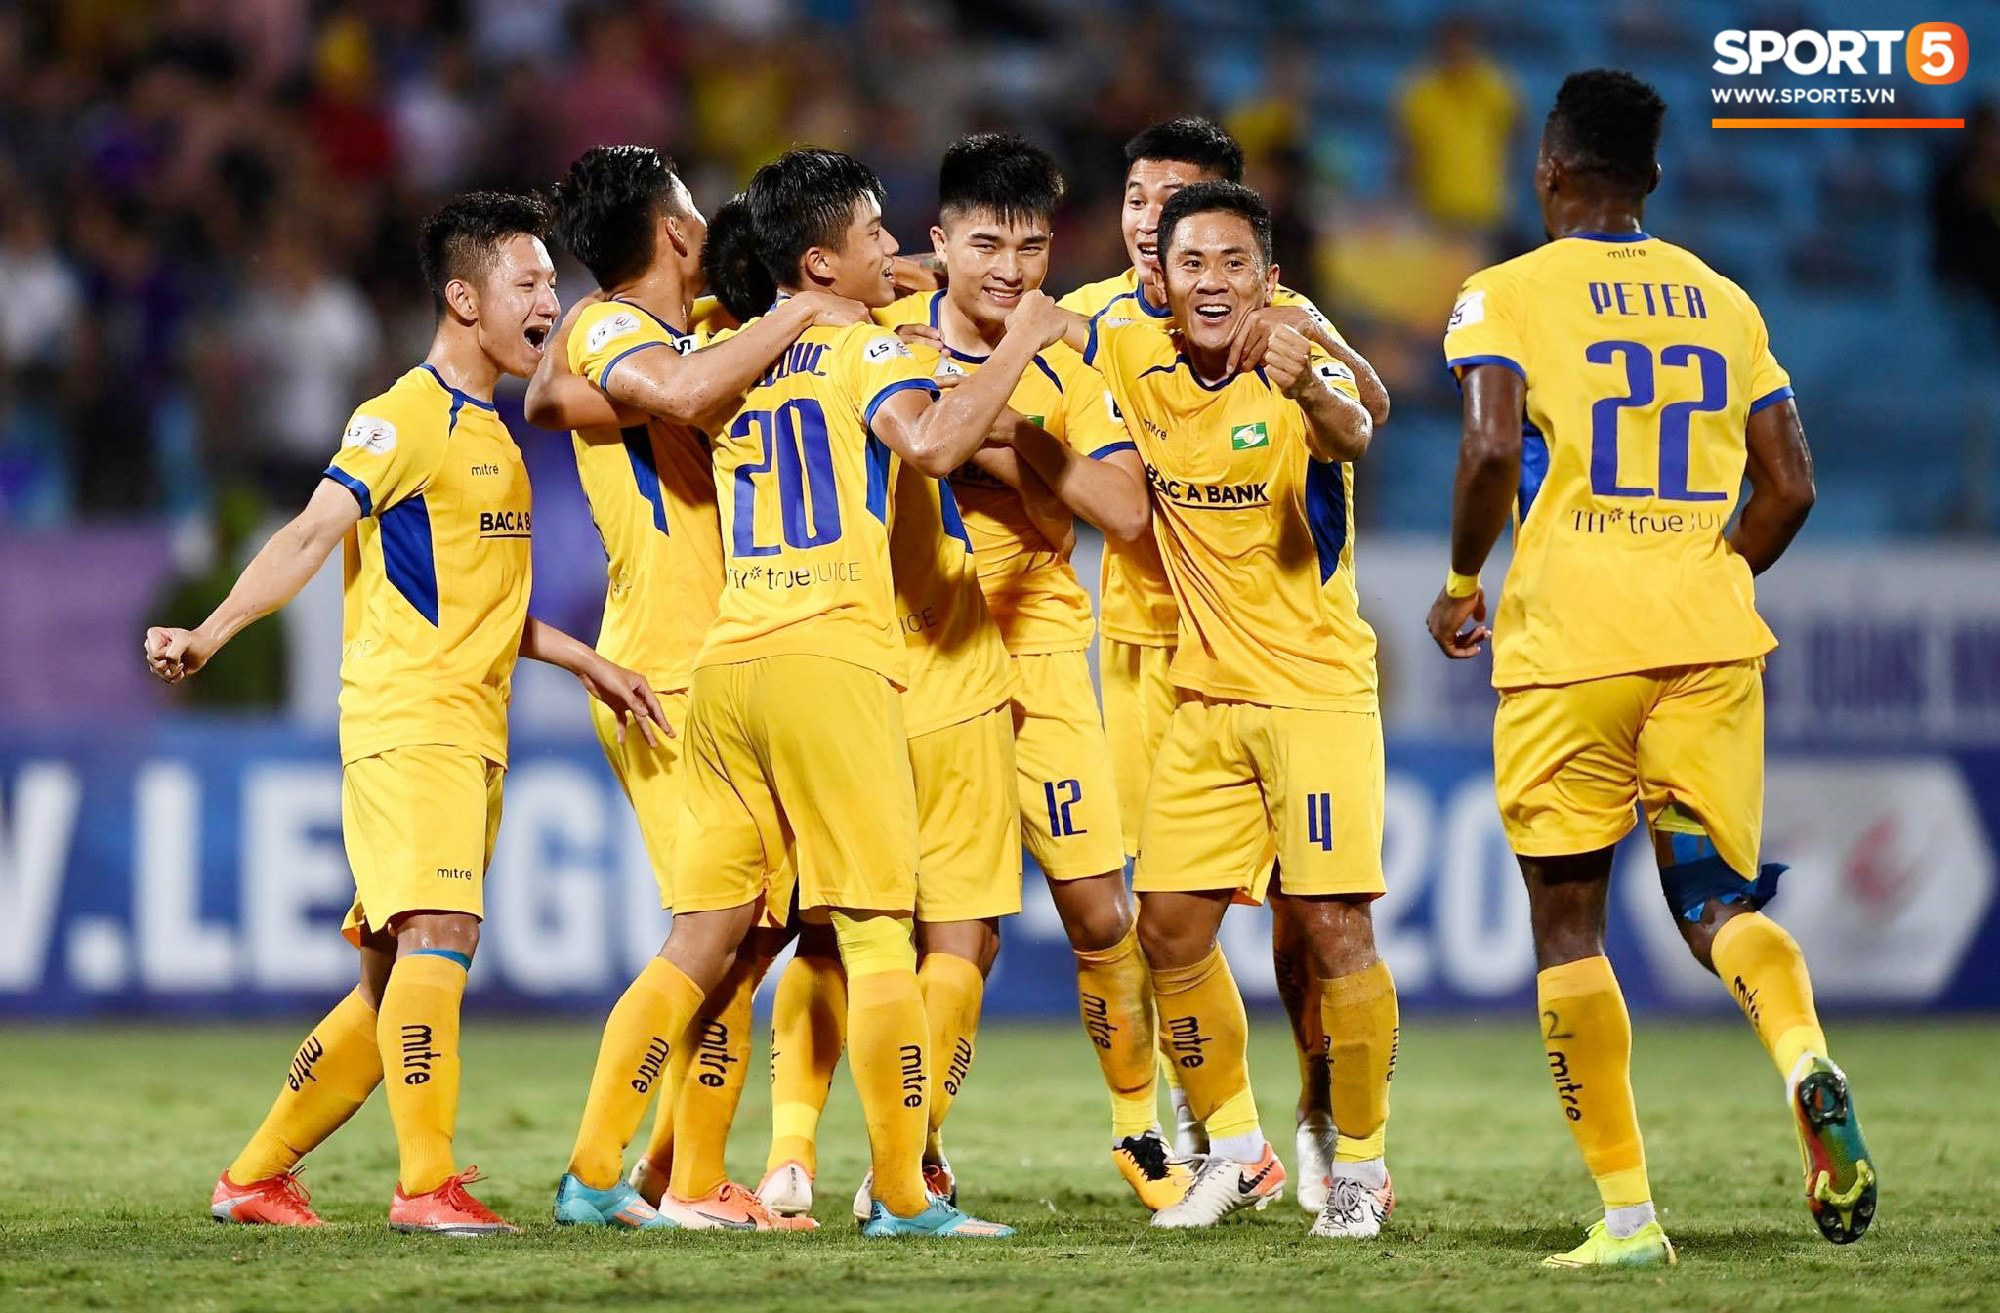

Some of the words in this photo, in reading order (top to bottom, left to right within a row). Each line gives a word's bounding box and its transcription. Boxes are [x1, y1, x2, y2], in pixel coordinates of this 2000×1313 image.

[1607, 247, 1646, 259] mitre
[1588, 281, 1708, 319] PETER
[869, 343, 890, 358] LS
[1585, 340, 1729, 500] 22
[471, 463, 499, 478] mitre
[730, 398, 842, 557] 20
[1187, 486, 1203, 502] A
[1205, 482, 1270, 504] BANK
[480, 512, 515, 532] BAC
[1629, 513, 1684, 534] true
[767, 568, 811, 590] true
[1043, 779, 1088, 837] 12
[1307, 792, 1333, 851] 4
[437, 868, 473, 881] mitre
[1082, 992, 1118, 1049] mitre
[1168, 1016, 1212, 1068] mitre
[288, 1035, 324, 1092] mitre
[401, 1024, 441, 1084] mitre
[631, 1036, 669, 1093] mitre
[699, 1018, 737, 1087] mitre
[900, 1045, 927, 1107] mitre
[943, 1037, 972, 1096] mitre
[1547, 1051, 1583, 1121] mitre
